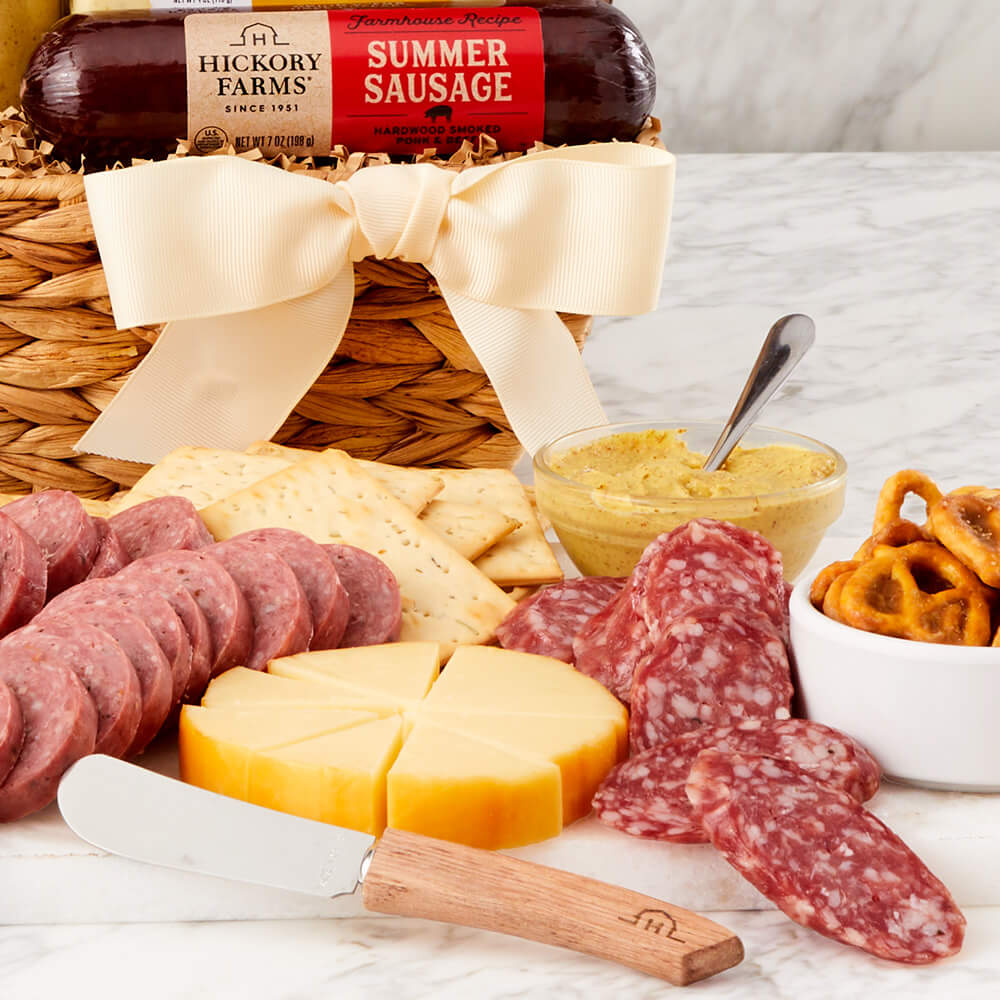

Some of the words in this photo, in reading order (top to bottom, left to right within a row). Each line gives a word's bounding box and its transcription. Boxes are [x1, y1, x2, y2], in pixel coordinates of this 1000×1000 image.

[347, 15, 454, 31] Farmhouse
[457, 13, 523, 27] Recipe
[198, 53, 322, 73] HICKORY
[367, 39, 510, 69] SUMMER
[217, 76, 307, 96] FARMS
[364, 72, 512, 103] SAUSAGE
[225, 104, 265, 113] SINCE
[272, 104, 298, 112] 1951
[374, 125, 446, 136] HARDWOOD
[450, 124, 502, 135] SMOKED
[235, 136, 250, 147] NET
[252, 136, 265, 147] WT
[267, 136, 273, 147] 7
[274, 136, 284, 147] OZ
